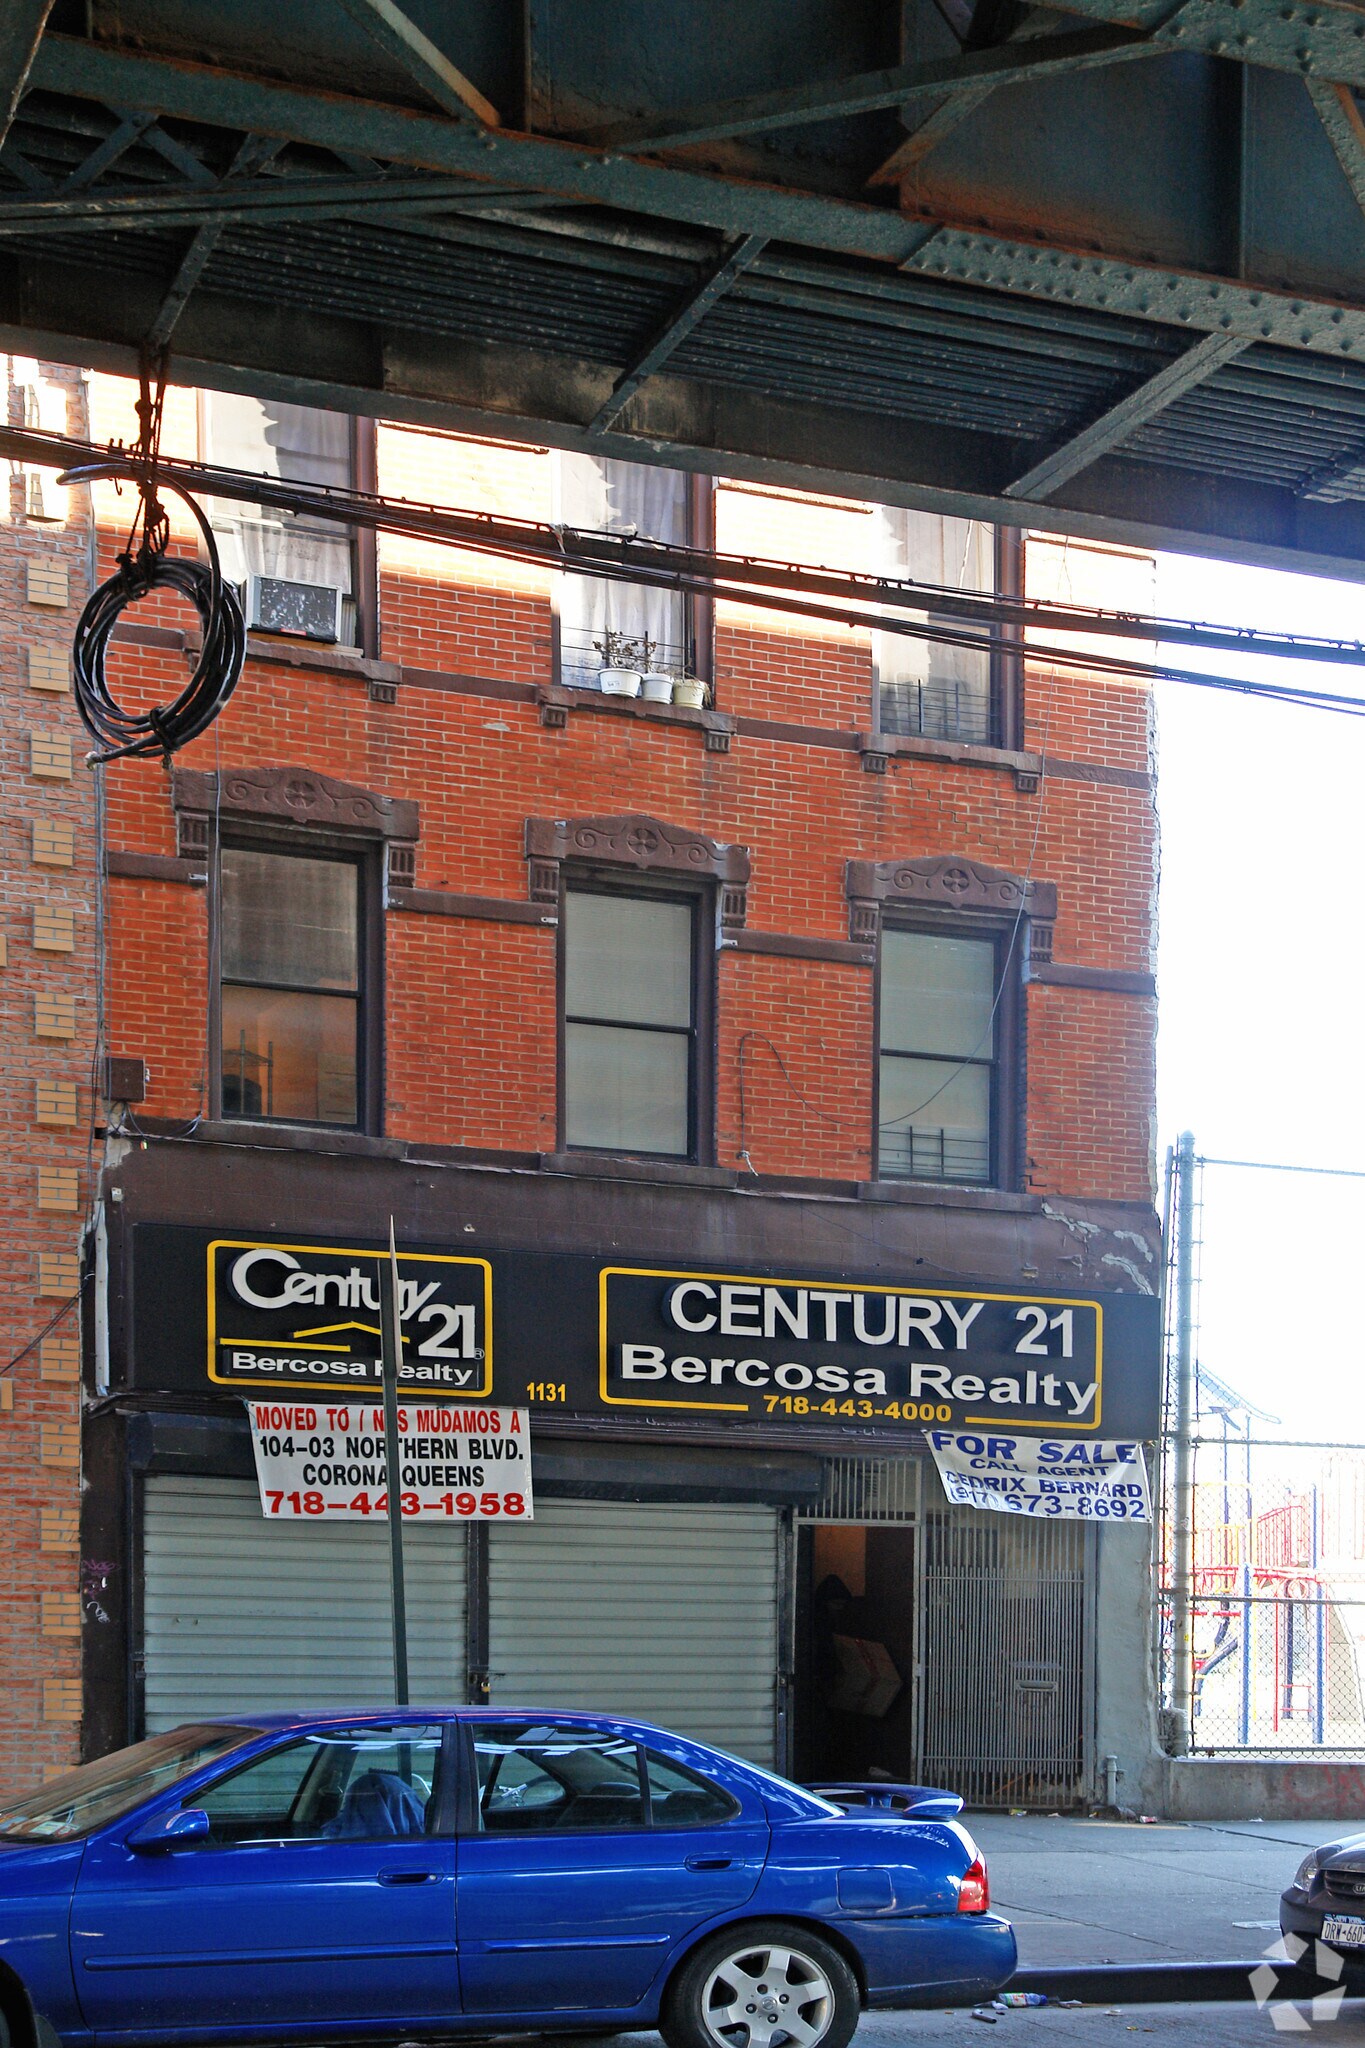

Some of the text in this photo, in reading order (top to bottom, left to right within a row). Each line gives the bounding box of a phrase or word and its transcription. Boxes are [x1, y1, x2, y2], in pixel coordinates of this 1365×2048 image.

[231, 1248, 476, 1359] Century 21
[670, 1281, 1073, 1358] CENTURY 21
[232, 1351, 367, 1377] Bercosa
[526, 1382, 566, 1402] 1131
[622, 1343, 1100, 1416] Bercosa Realty
[256, 1406, 317, 1431] MOVED
[326, 1408, 349, 1432] TO
[373, 1409, 408, 1433] NS
[416, 1409, 501, 1434] MUDAMOS
[510, 1410, 521, 1434] A
[763, 1395, 952, 1422] 718-443-4000
[260, 1436, 523, 1460] 104-03 NORHERN BLVD.
[931, 1431, 1137, 1464] FOR SALE
[303, 1464, 485, 1488] CORONA QUEENS
[969, 1458, 1109, 1477] CALL AGENT
[945, 1470, 1143, 1498] CEDRIX BERNARD
[265, 1490, 526, 1516] 718-443-1958
[1004, 1493, 1146, 1519] 673-8692
